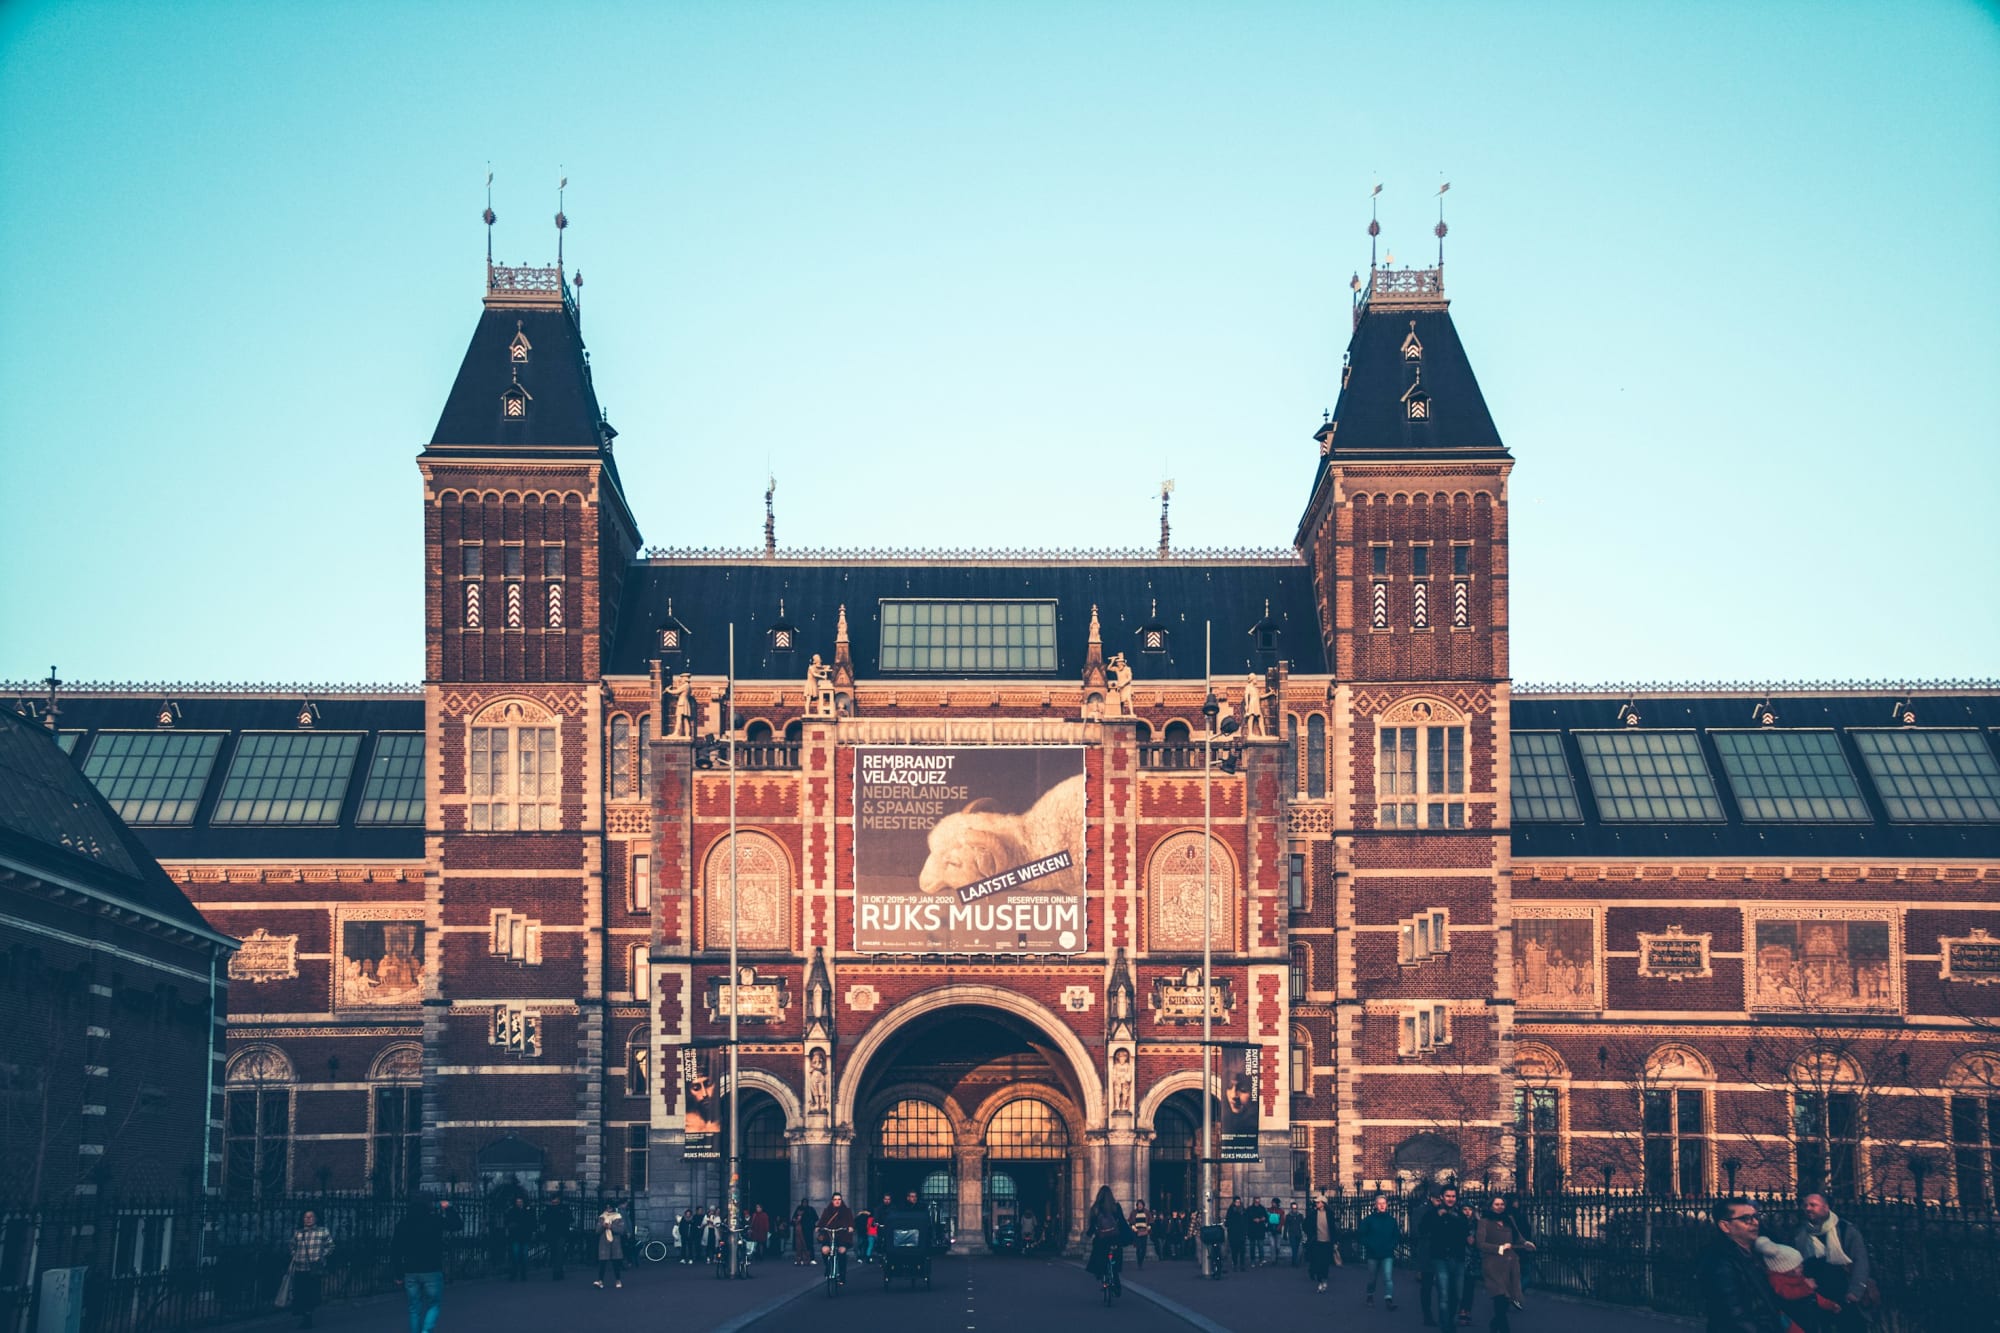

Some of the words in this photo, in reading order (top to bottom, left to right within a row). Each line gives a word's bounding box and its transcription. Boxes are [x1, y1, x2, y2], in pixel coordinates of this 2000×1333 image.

[863, 755, 955, 769] REMBRANDT
[862, 768, 946, 787] VELÁZQUEZ
[862, 786, 968, 799] NEDERLANDSE
[862, 801, 874, 814] &
[877, 801, 944, 815] SPAANSE
[862, 816, 935, 829] MEESTERS
[960, 872, 1017, 902] LAATSTE
[1017, 853, 1070, 881] WEKEN!
[918, 896, 934, 904] JAN
[935, 896, 955, 904] 2020
[1007, 896, 1049, 904] RESERVEER
[1051, 896, 1078, 904] ONLINE
[862, 904, 941, 931] RIJKS
[949, 904, 1078, 931] MUSEUM
